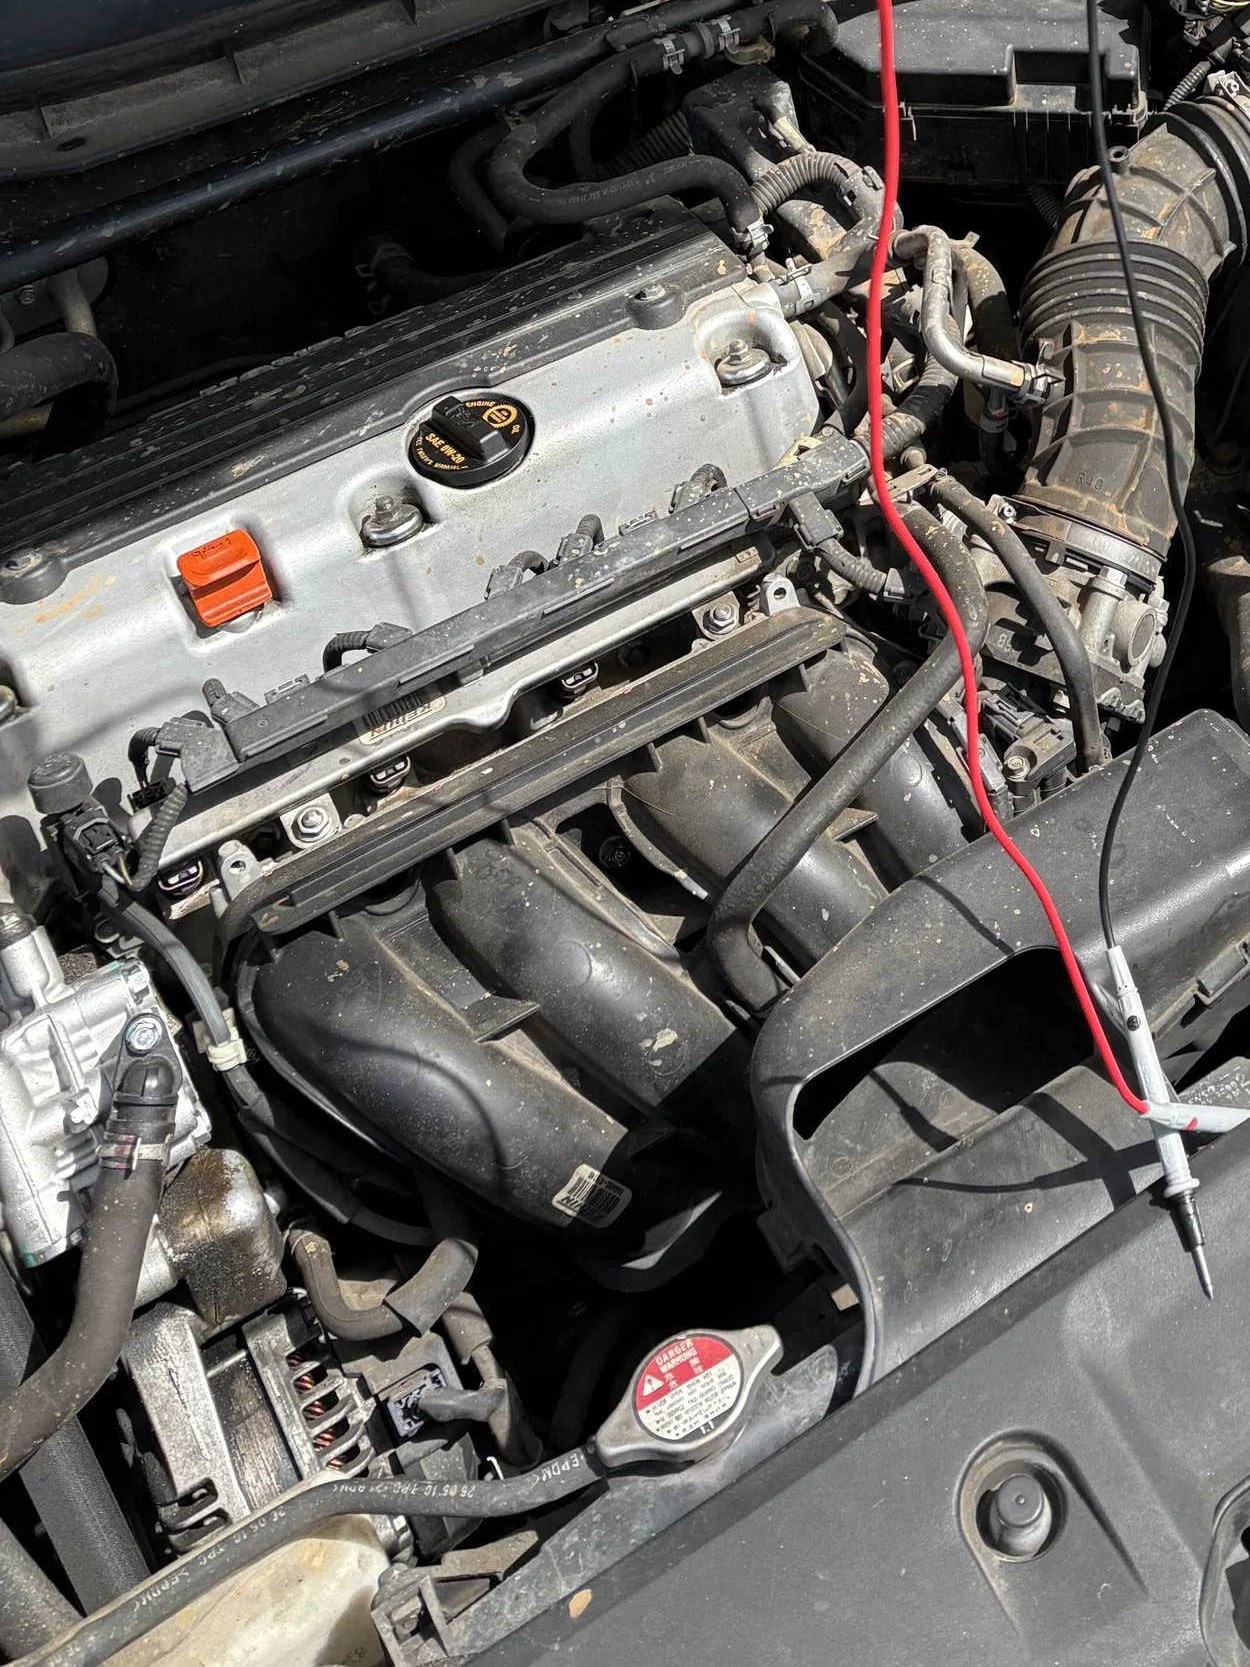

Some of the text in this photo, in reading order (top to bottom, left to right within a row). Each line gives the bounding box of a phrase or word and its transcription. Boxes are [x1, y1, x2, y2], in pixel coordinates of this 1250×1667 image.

[425, 433, 466, 465] SAE 0W-20
[655, 1337, 694, 1366] DANGER
